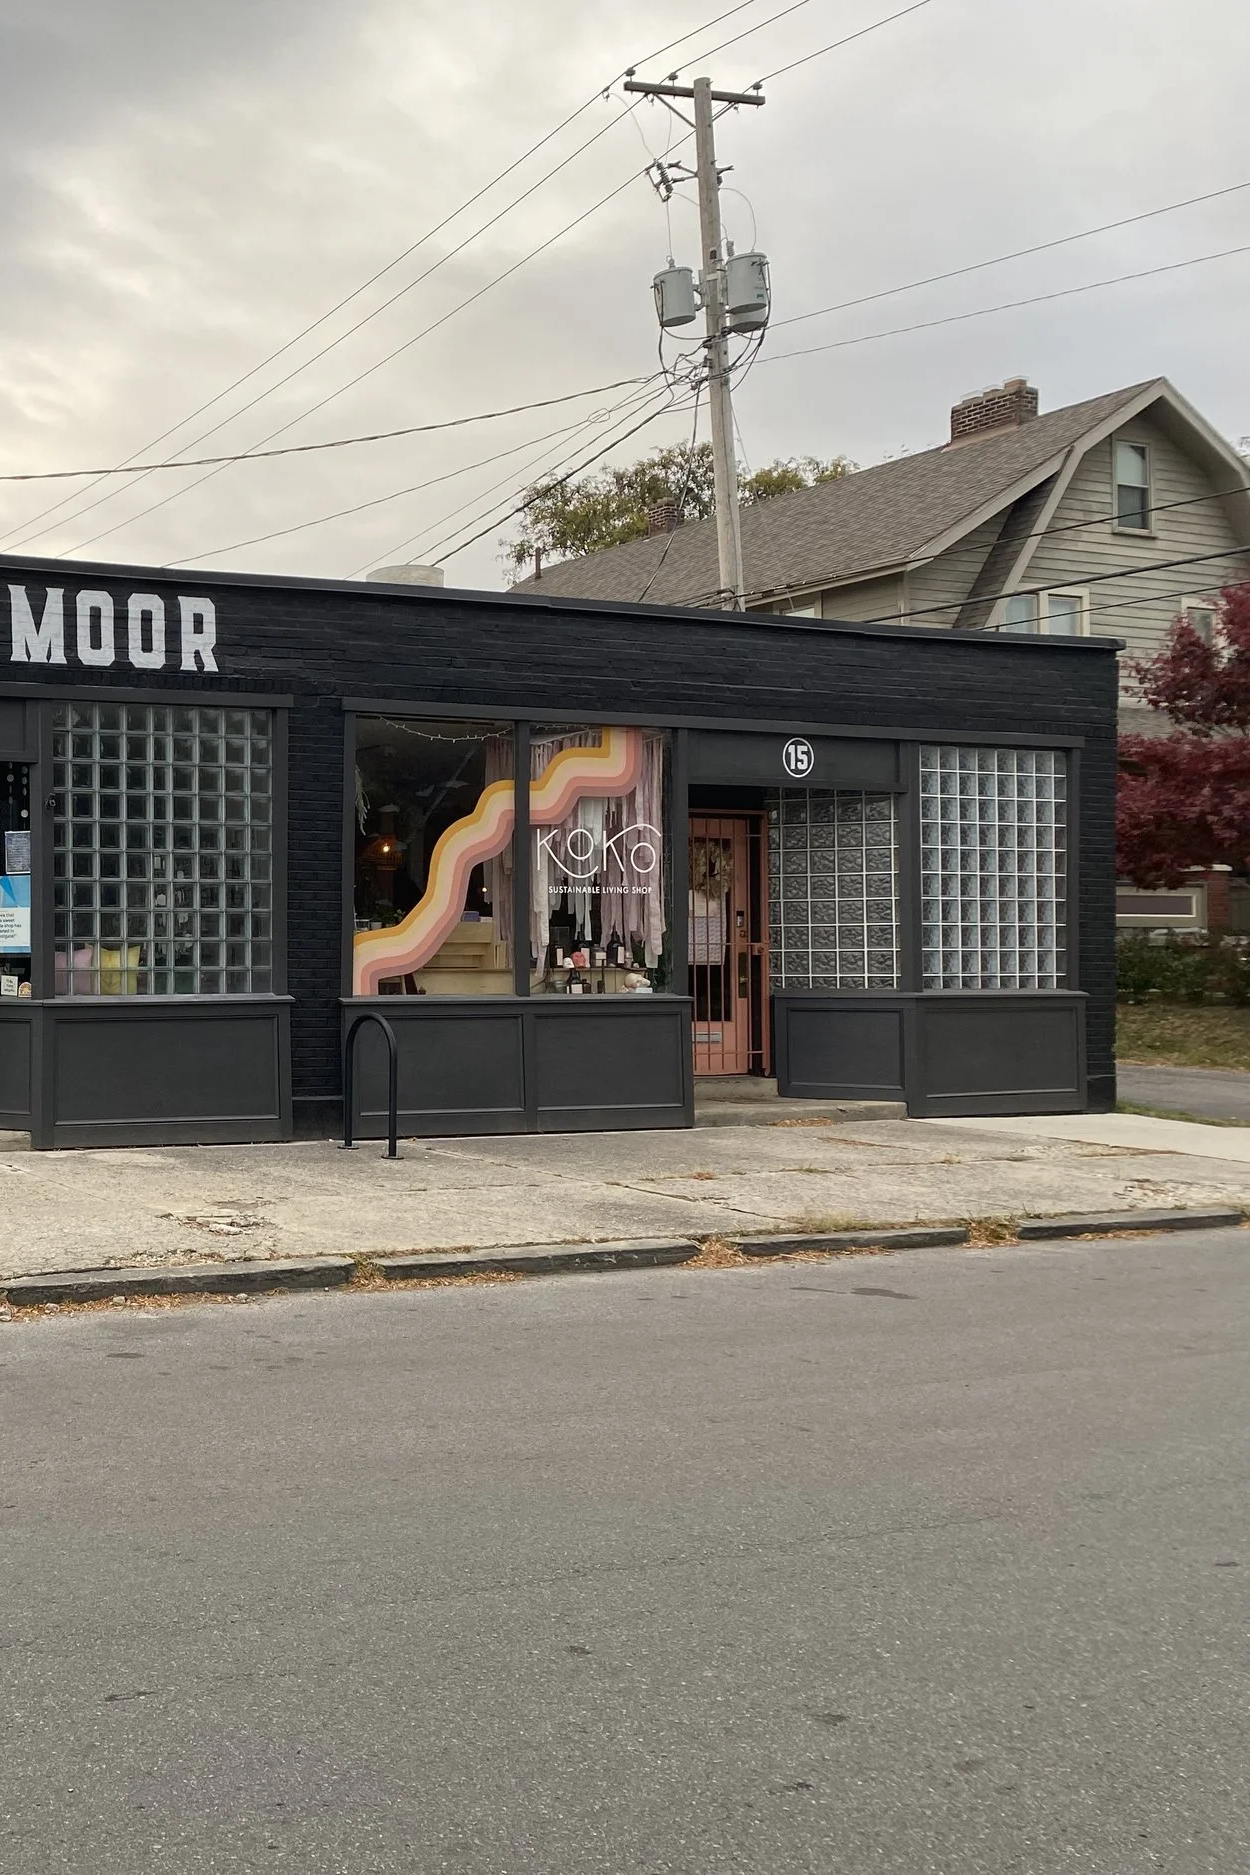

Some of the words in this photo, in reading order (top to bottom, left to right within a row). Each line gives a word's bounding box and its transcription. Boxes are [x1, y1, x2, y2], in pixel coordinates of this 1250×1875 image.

[788, 744, 808, 770] 15
[548, 886, 600, 894] SUSTAINABLE
[602, 886, 629, 894] LIVING
[631, 886, 652, 894] SHOP
